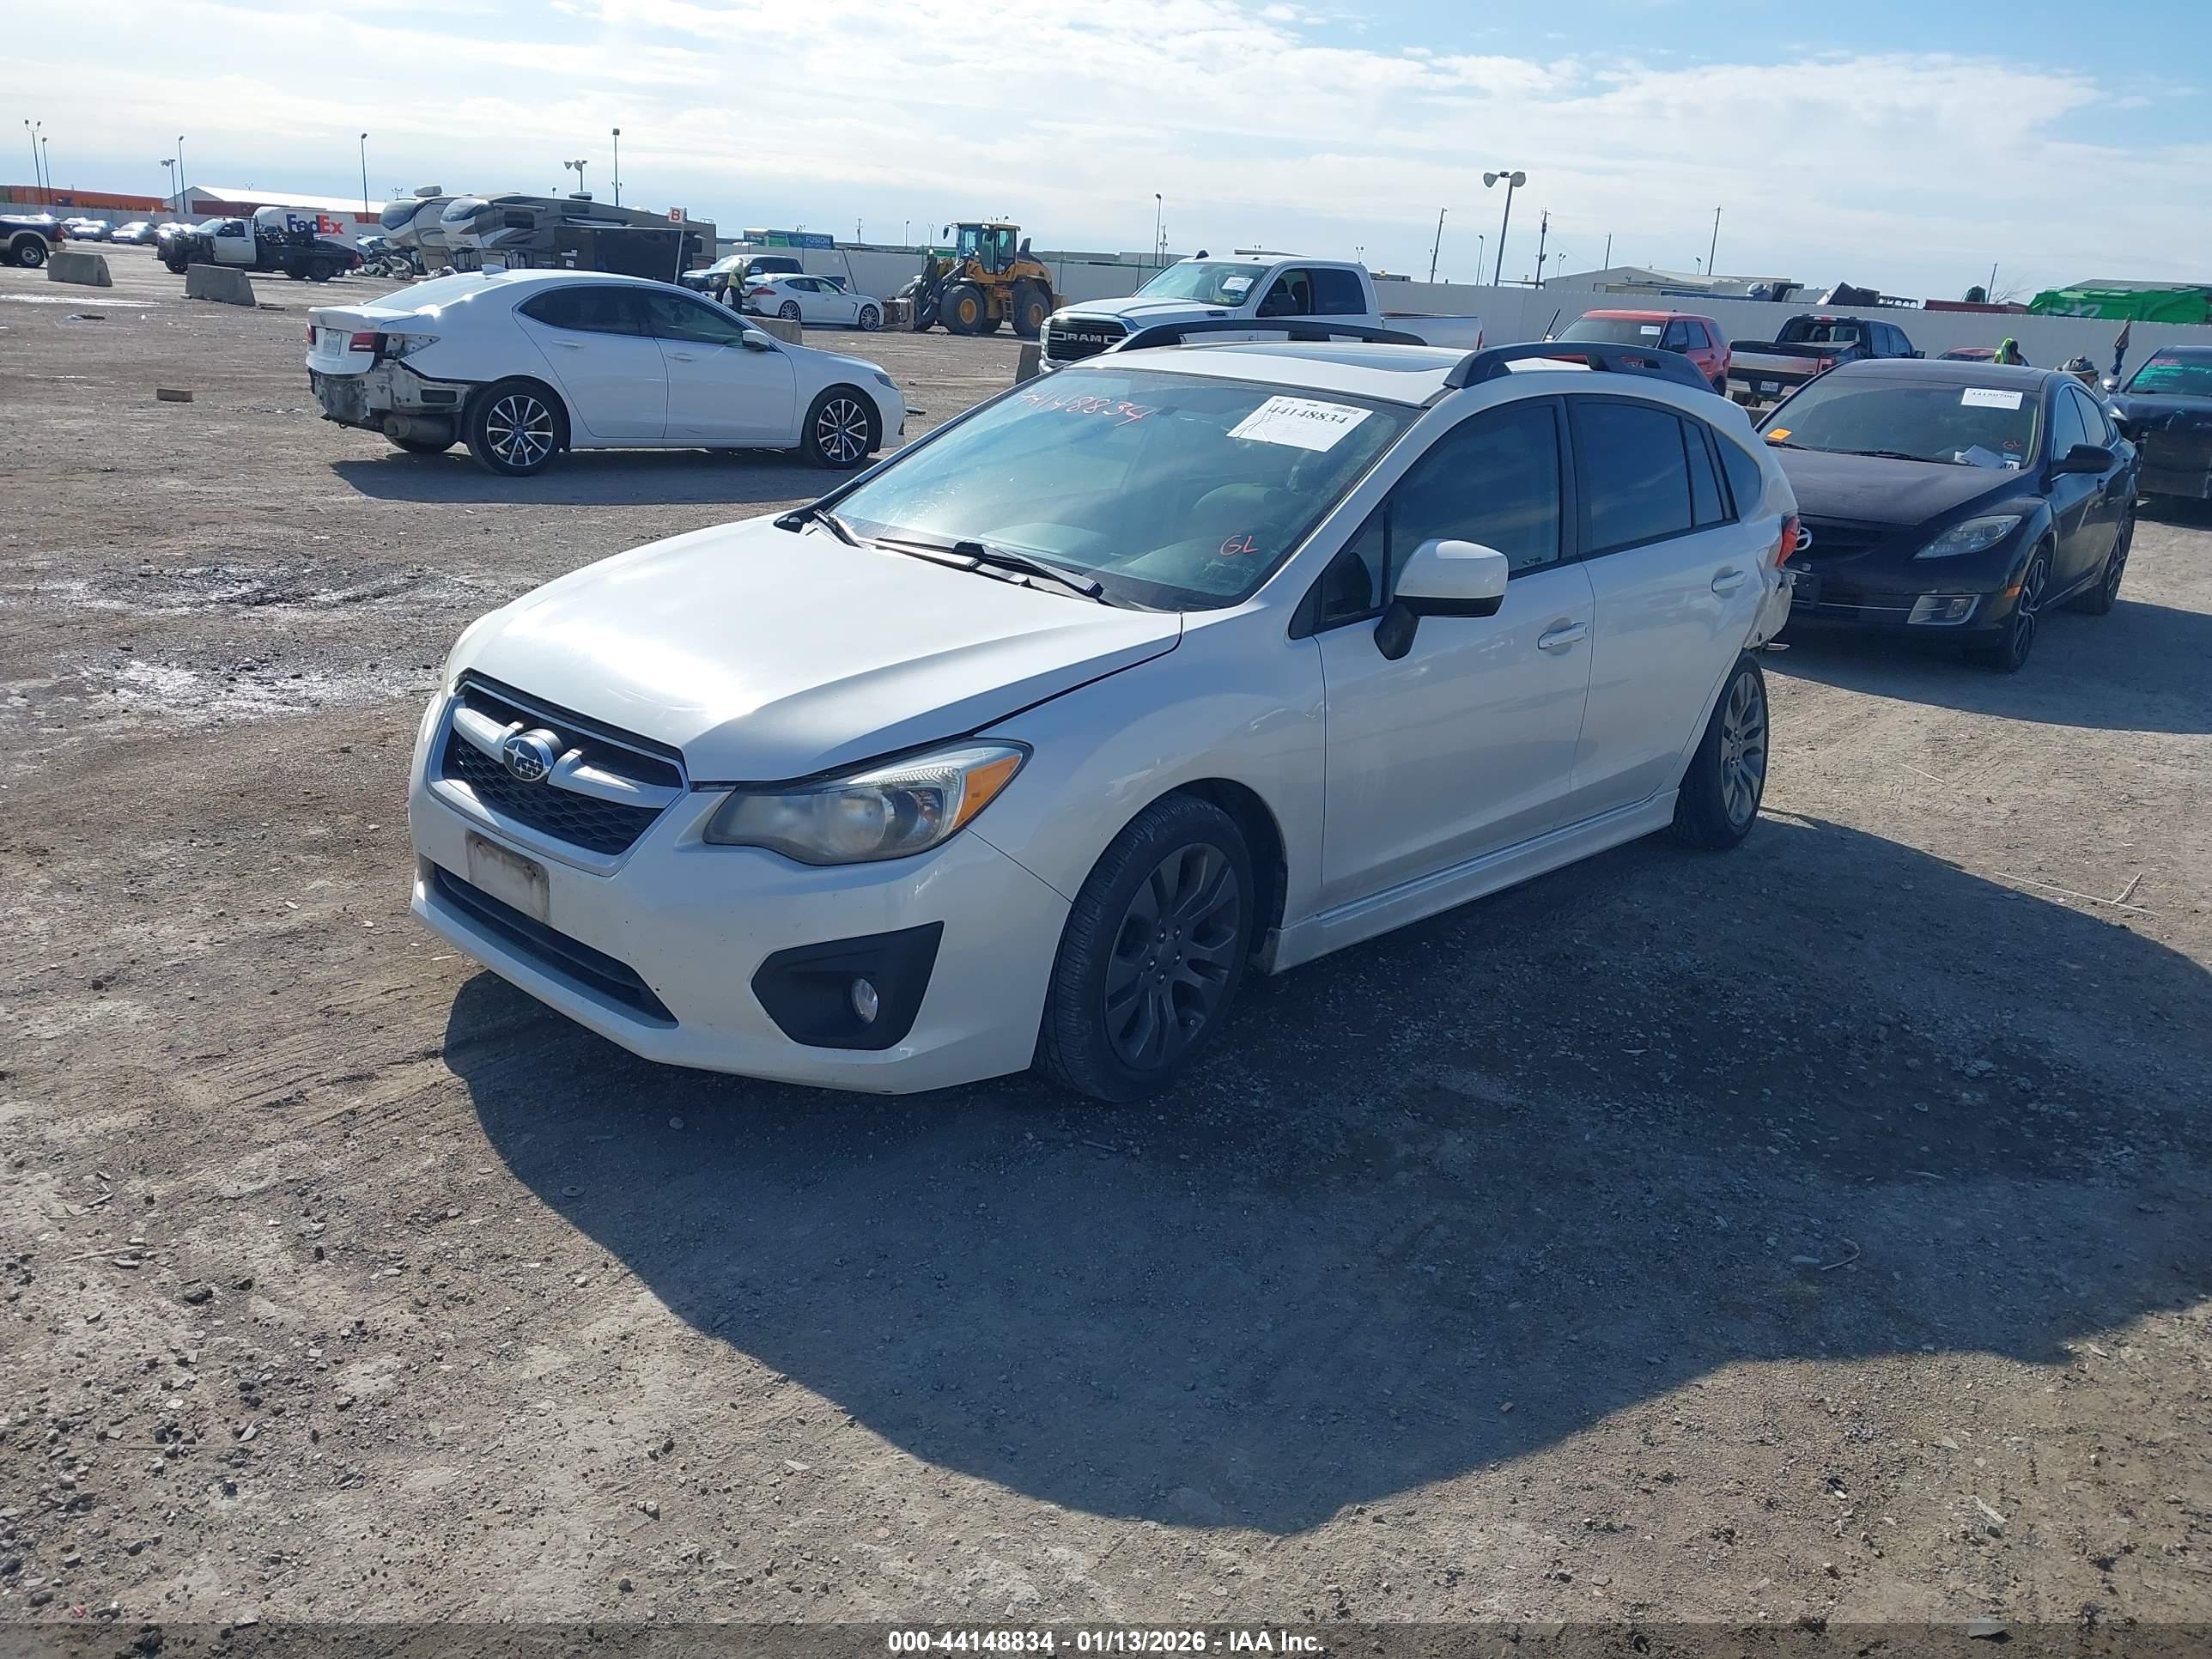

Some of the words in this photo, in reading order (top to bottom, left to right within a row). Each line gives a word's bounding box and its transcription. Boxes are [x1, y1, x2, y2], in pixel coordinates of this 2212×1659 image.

[672, 210, 681, 221] B
[286, 214, 343, 234] FedEx
[805, 235, 830, 245] FUSION
[1067, 332, 1102, 343] RAM
[1268, 405, 1348, 425] 44148834
[2002, 440, 2021, 450] GL
[1219, 534, 1260, 556] GL
